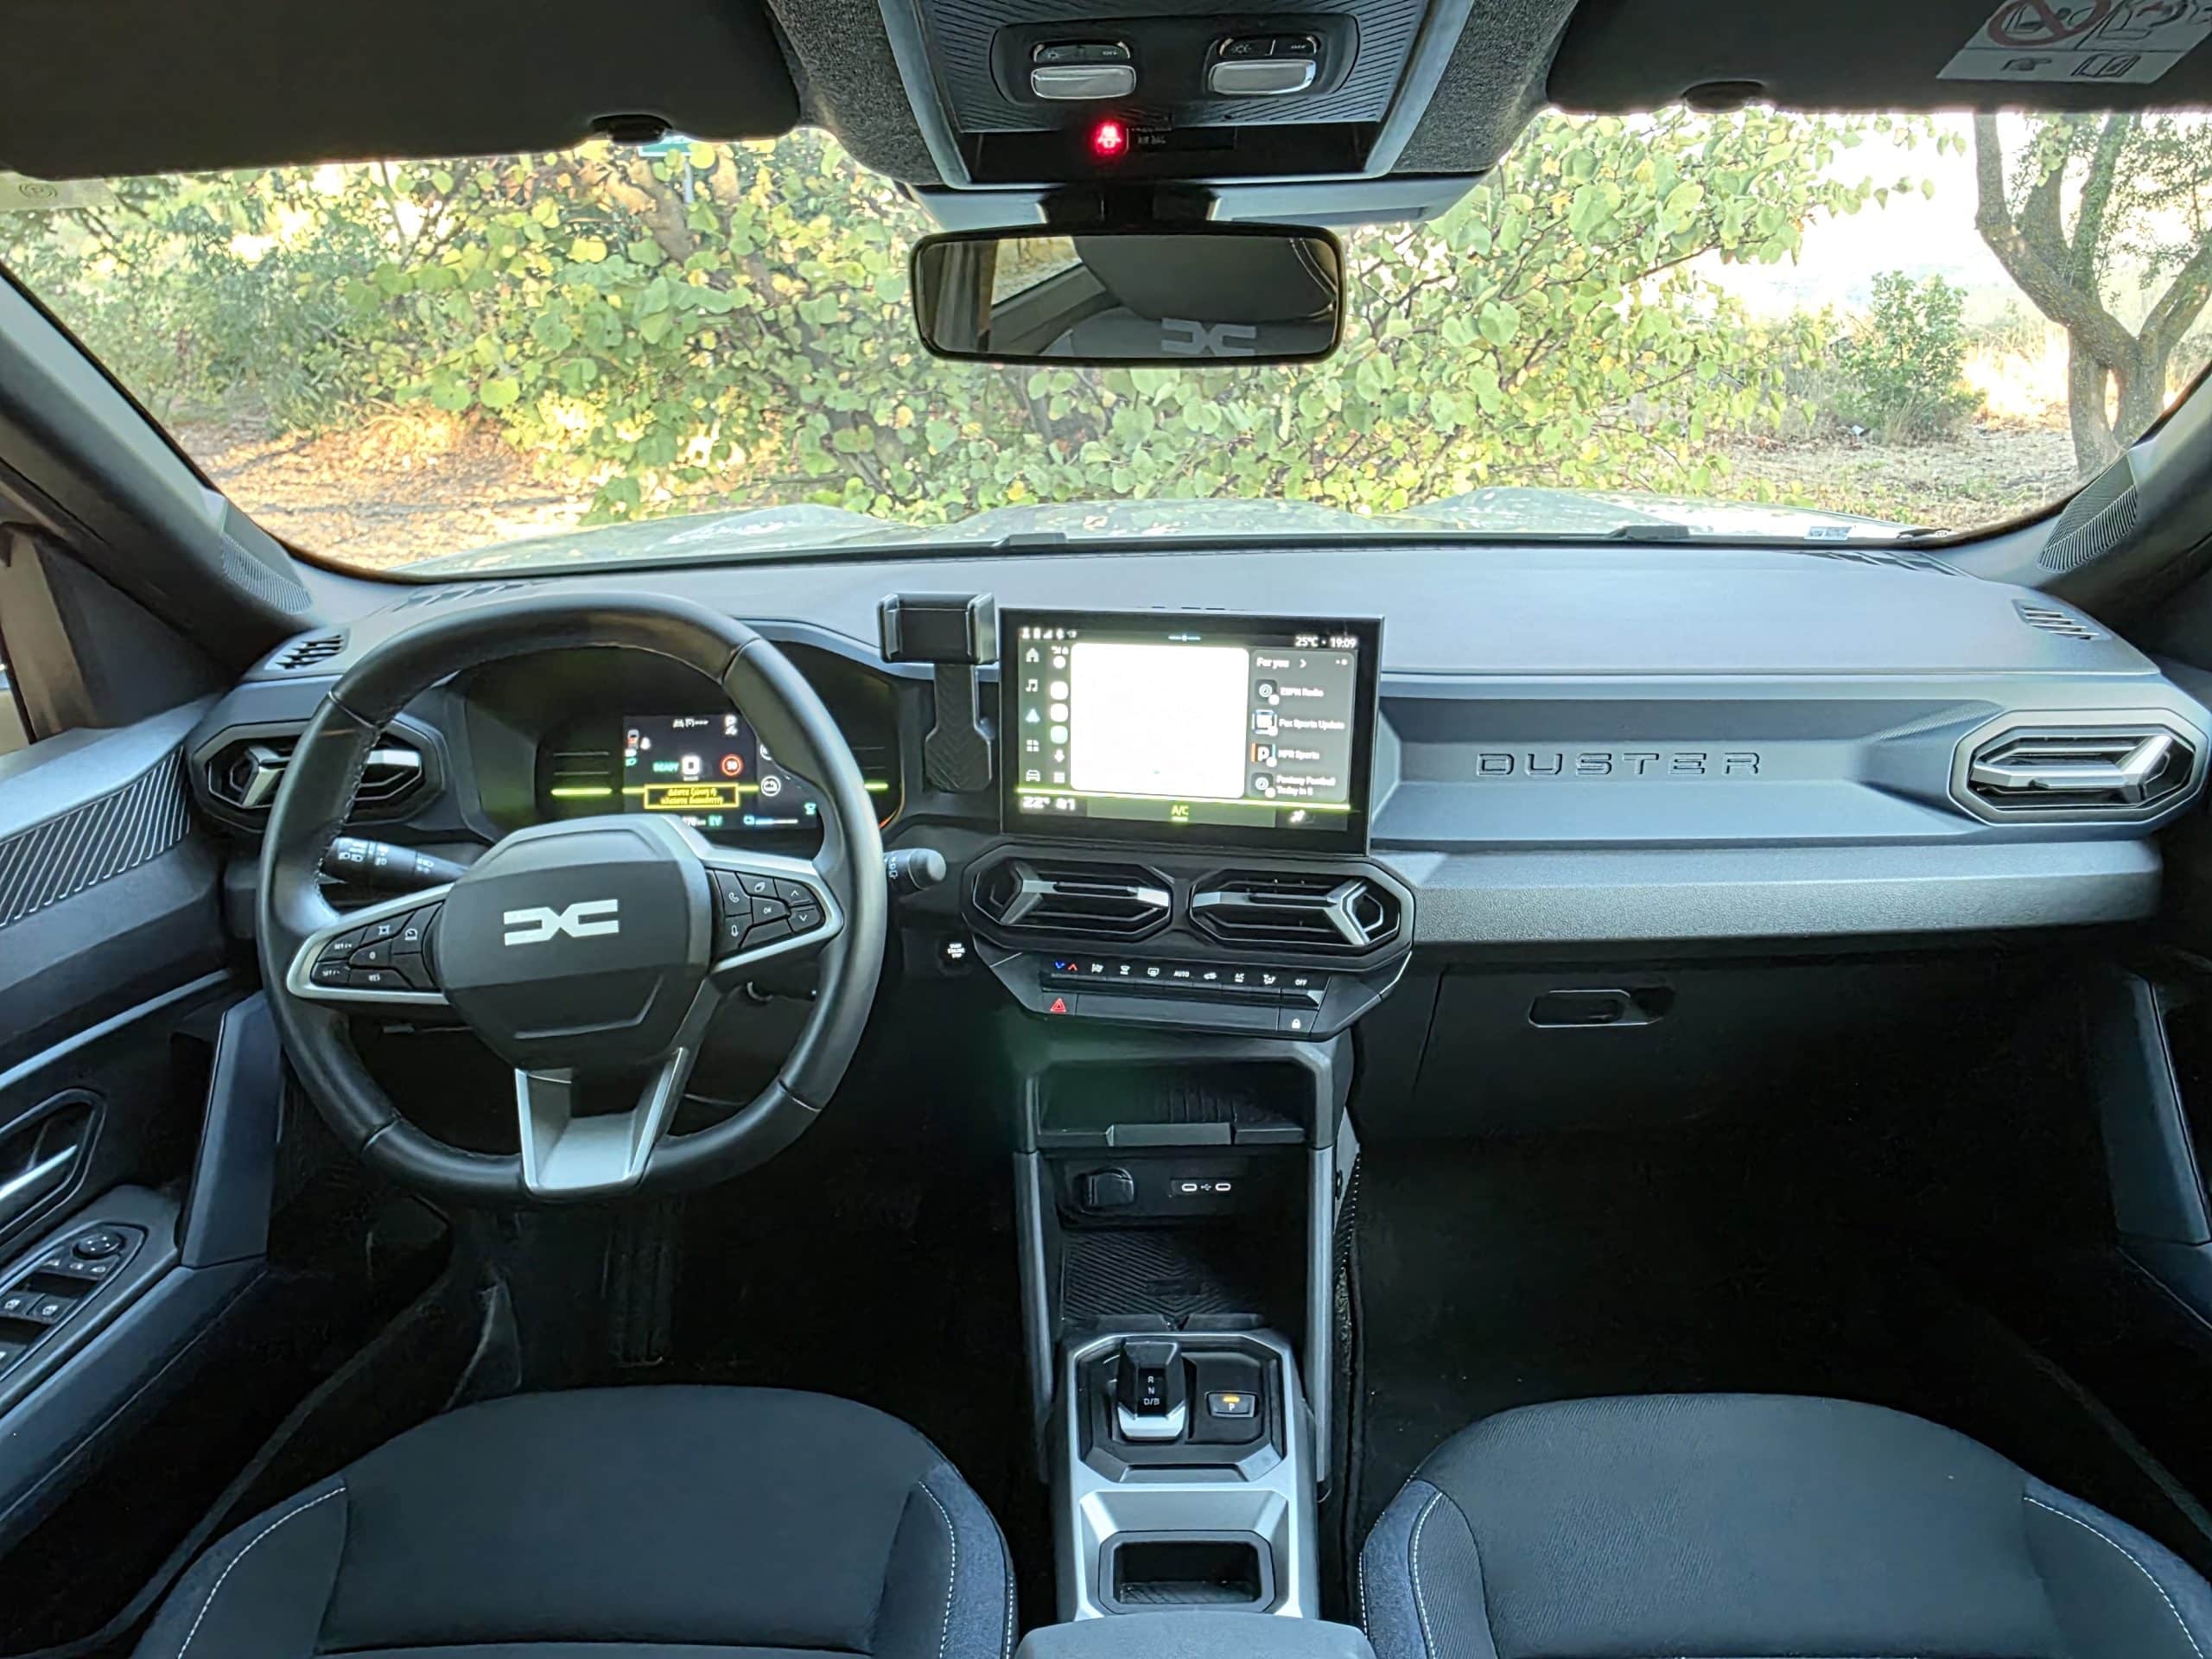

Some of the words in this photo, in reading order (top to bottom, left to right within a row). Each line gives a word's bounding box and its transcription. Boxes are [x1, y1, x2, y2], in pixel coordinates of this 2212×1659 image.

[1331, 636, 1357, 649] 19:09
[1476, 753, 1760, 776] DUSTER
[1171, 804, 1189, 816] A/C
